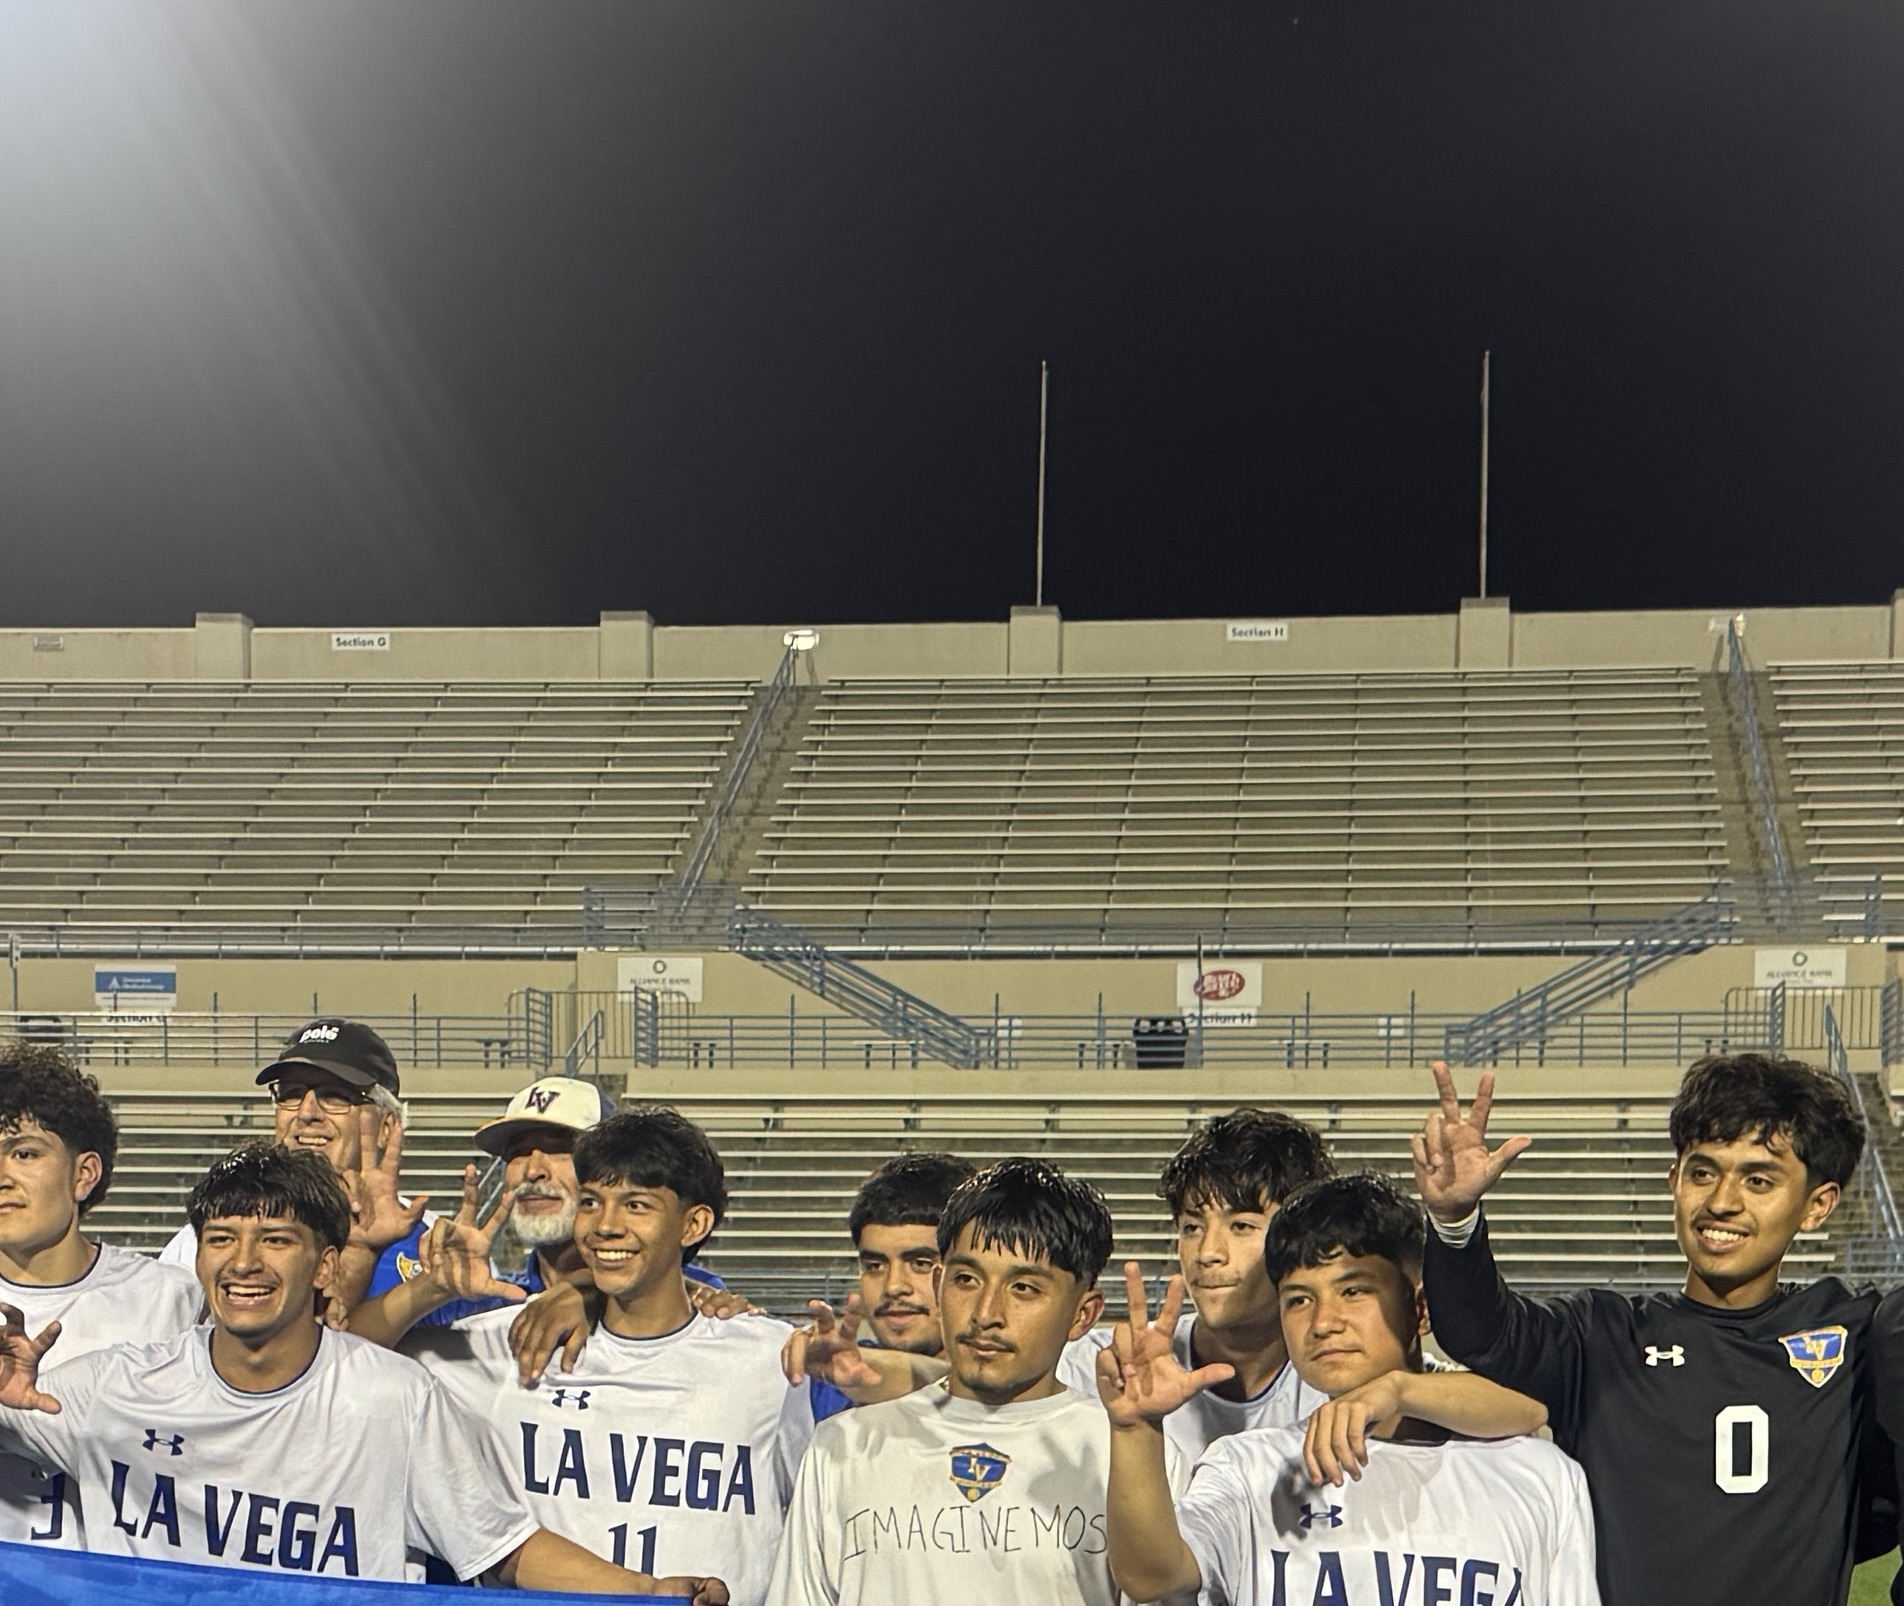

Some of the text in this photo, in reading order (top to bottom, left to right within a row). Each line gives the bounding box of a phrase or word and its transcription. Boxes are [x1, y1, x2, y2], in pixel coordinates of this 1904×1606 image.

[520, 1421, 756, 1516] LA VEGA
[1715, 1405, 1770, 1494] 0
[111, 1459, 360, 1577] LA VEGA
[843, 1503, 1108, 1561] IMAGINEMOS
